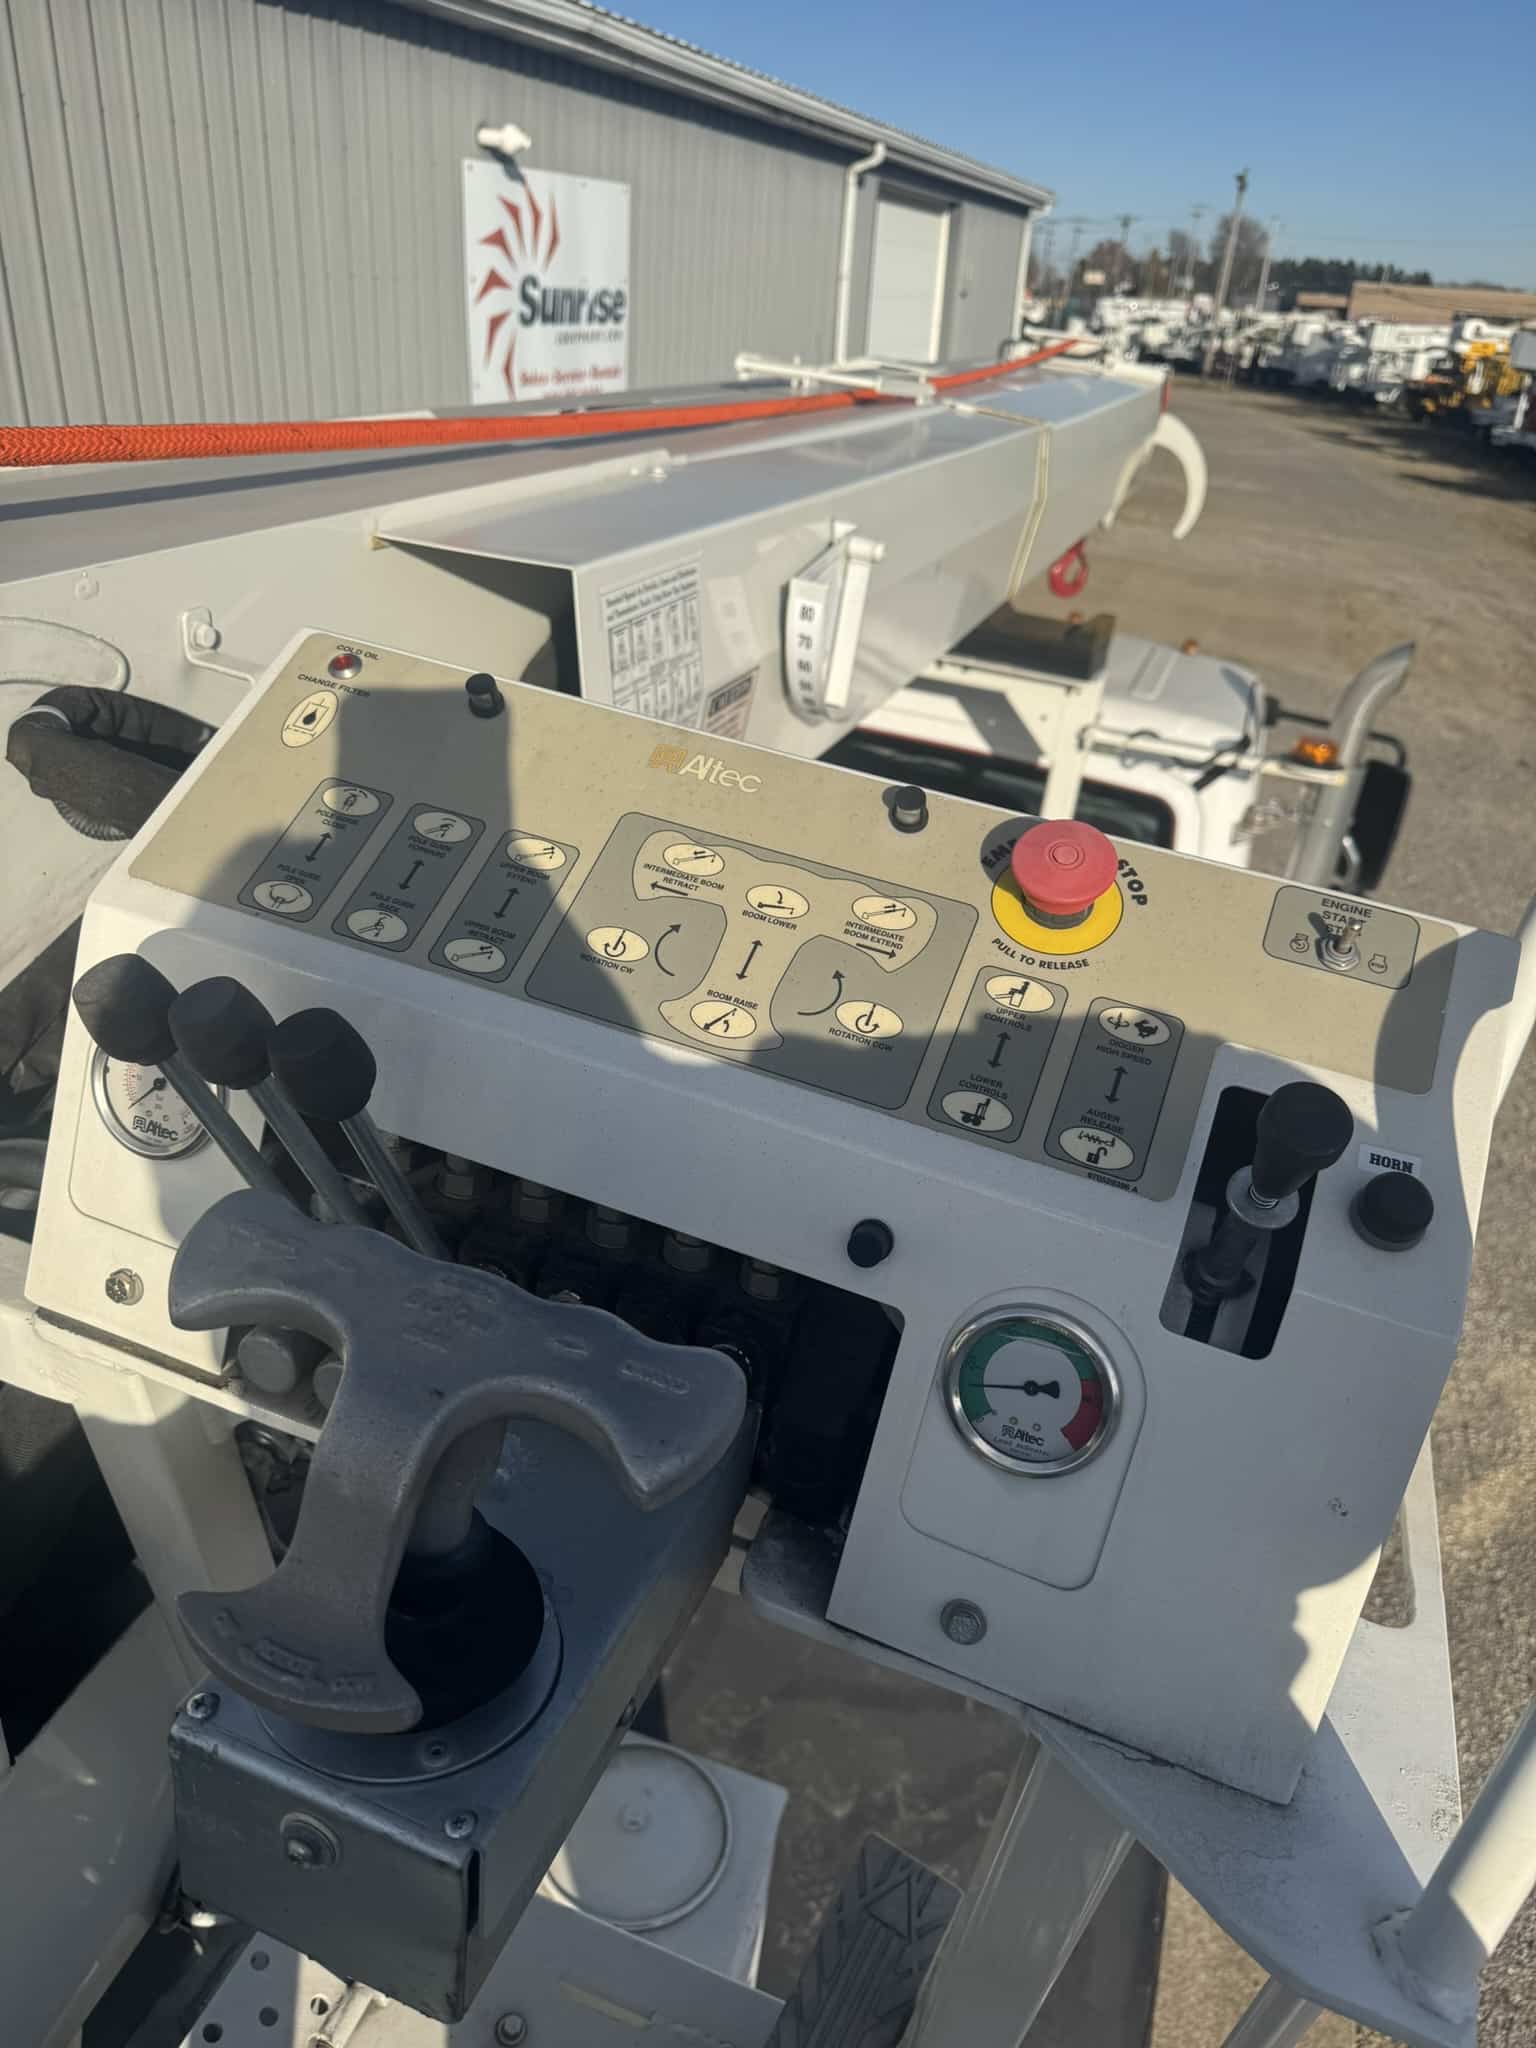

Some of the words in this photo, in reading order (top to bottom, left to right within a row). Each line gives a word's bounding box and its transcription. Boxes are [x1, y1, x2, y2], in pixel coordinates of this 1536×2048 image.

[519, 274, 625, 327] Sunrise
[336, 644, 363, 655] COLD
[364, 651, 380, 661] OIL
[297, 673, 338, 689] CHANGE
[338, 684, 371, 697] FILTER
[679, 754, 763, 793] Altec
[642, 863, 700, 884] INTERMEDIATE
[699, 877, 725, 892] BOOM
[661, 876, 701, 892] RETRACT
[1117, 858, 1149, 906] STOP
[1320, 898, 1374, 919] ENGINE
[741, 908, 768, 923] BOOM
[767, 915, 798, 932] LOWER
[491, 927, 517, 940] BOOM
[843, 928, 870, 943] BOOM
[869, 934, 904, 951] EXTEND
[845, 920, 905, 943] INTERMEDIATE
[579, 952, 621, 972] ROTATION
[619, 963, 635, 976] CW
[991, 936, 1017, 960] PULL
[1018, 953, 1036, 967] TO
[1038, 957, 1090, 971] RELEASE
[706, 988, 734, 1003] BOOM
[733, 995, 759, 1011] RAISE
[983, 1012, 1033, 1033] CONTROLS
[995, 1007, 1027, 1021] UPPER
[828, 1026, 873, 1047] ROTATION
[1108, 1038, 1145, 1055] DIGGER
[1096, 1044, 1120, 1058] HIGH
[958, 1079, 1009, 1100] CONTROLS
[969, 1073, 1004, 1089] LOWER
[1079, 1115, 1125, 1135] RELEASE
[1086, 1107, 1121, 1124] AUGER
[146, 1119, 179, 1142] Altec
[1368, 1152, 1415, 1174] HORN
[1014, 1428, 1045, 1447] Altec
